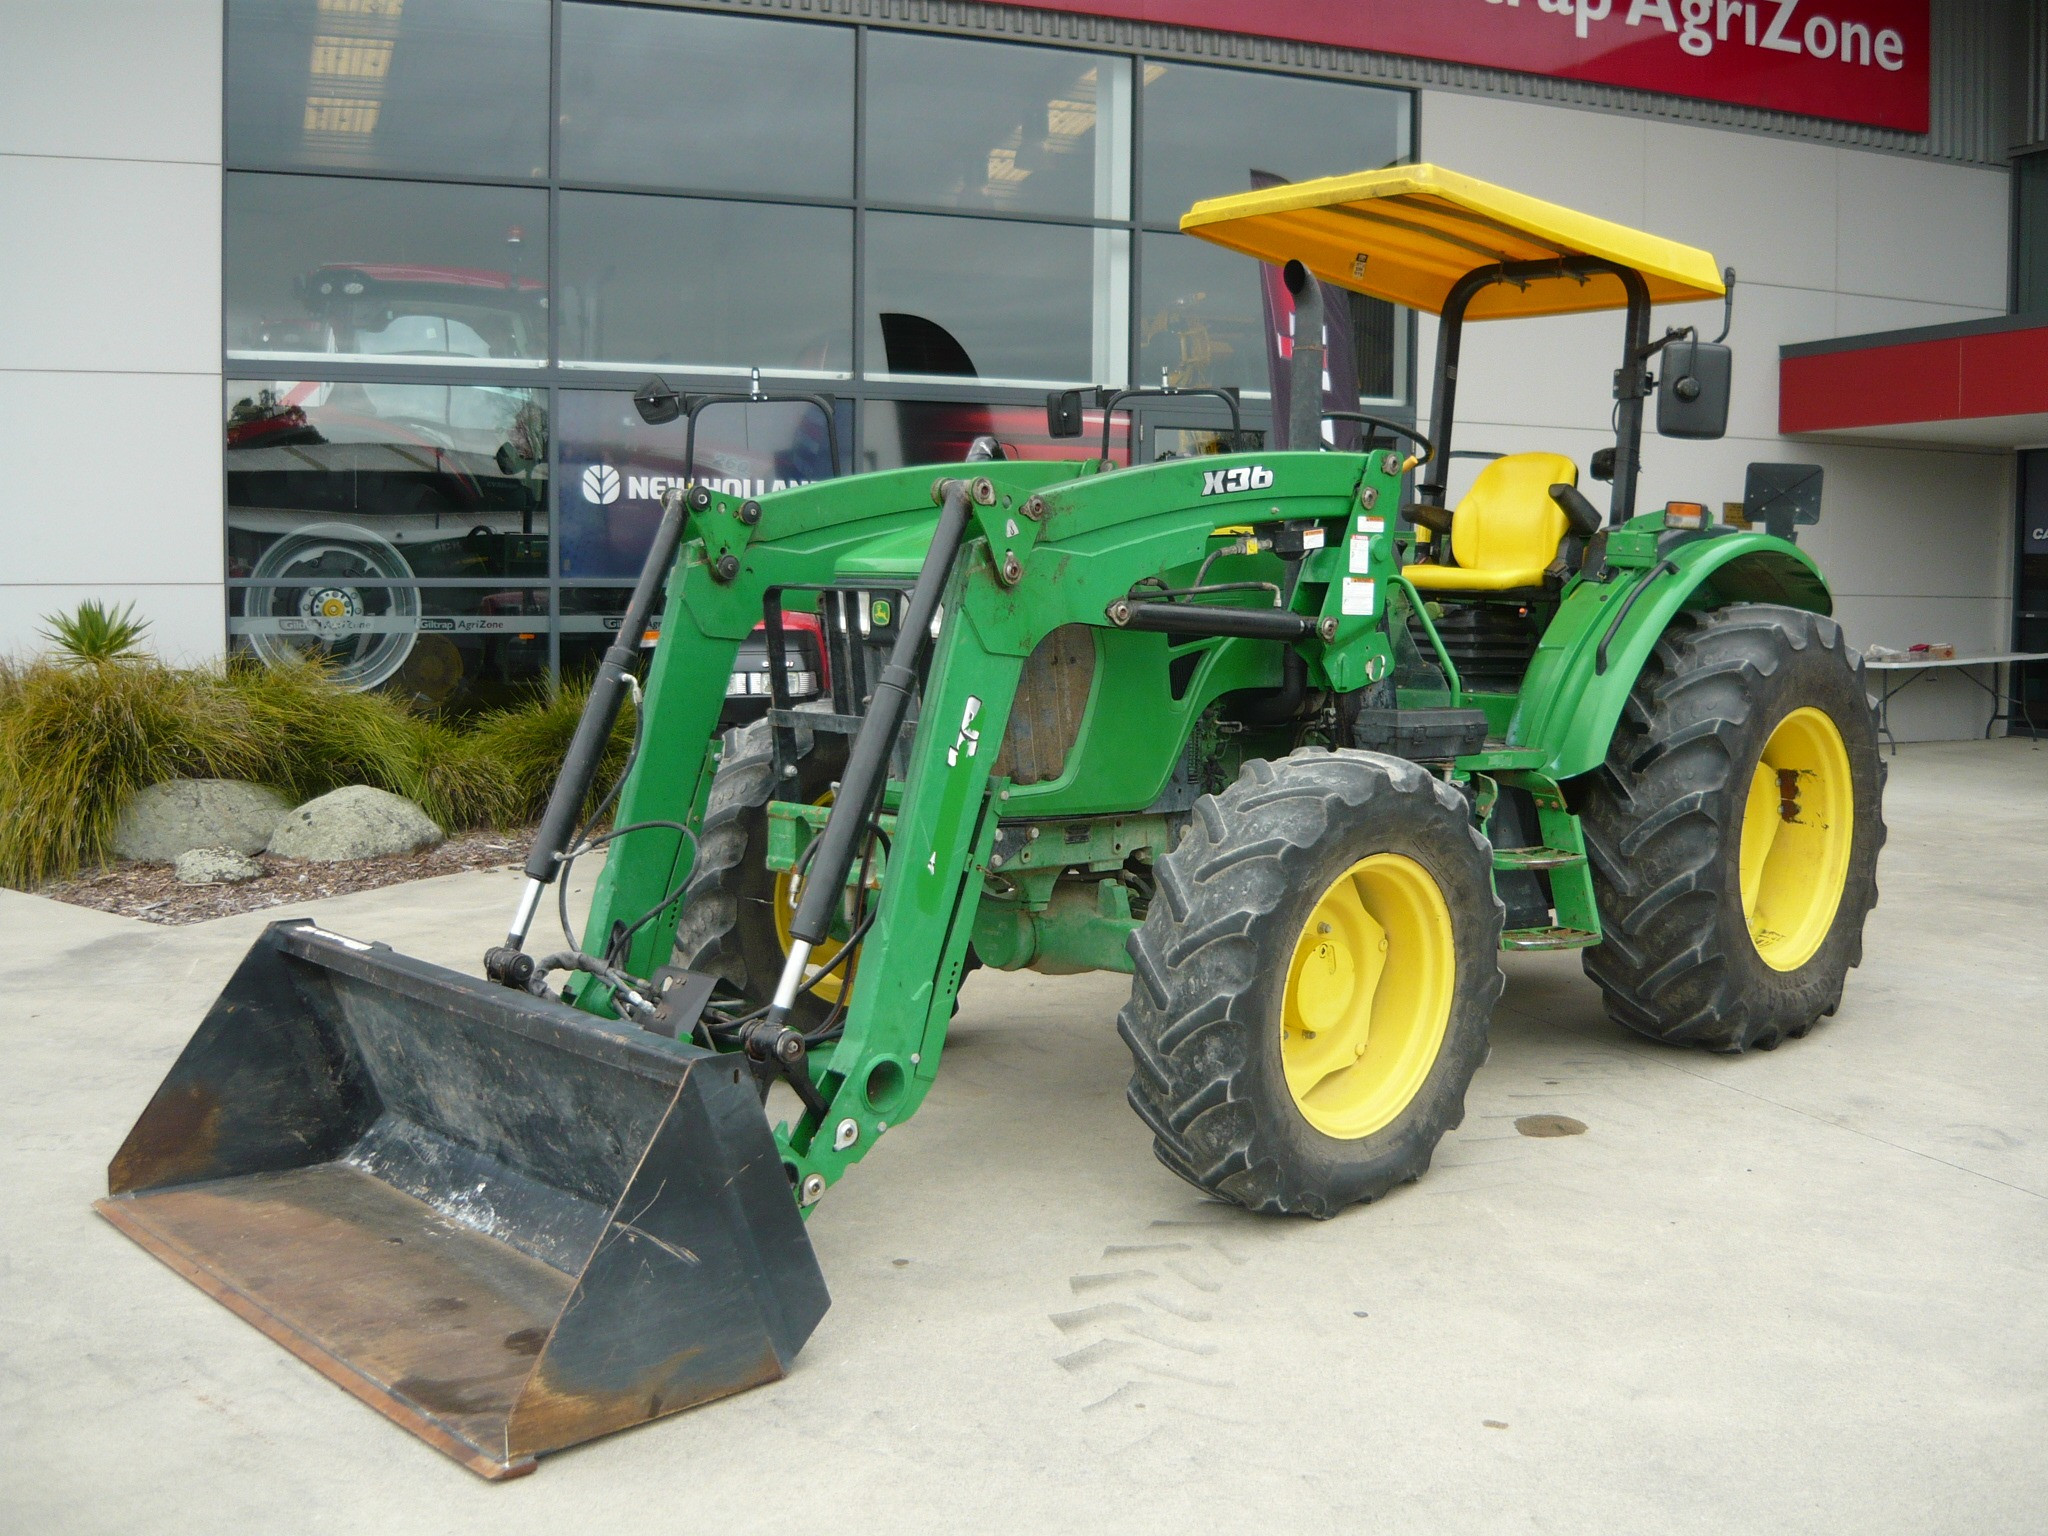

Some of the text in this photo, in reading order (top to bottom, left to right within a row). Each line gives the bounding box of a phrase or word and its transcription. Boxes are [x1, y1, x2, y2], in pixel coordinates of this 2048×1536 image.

[1625, 0, 1904, 71] AgriZone
[1202, 465, 1274, 496] X36
[420, 619, 504, 631] Giltrap AgriZone
